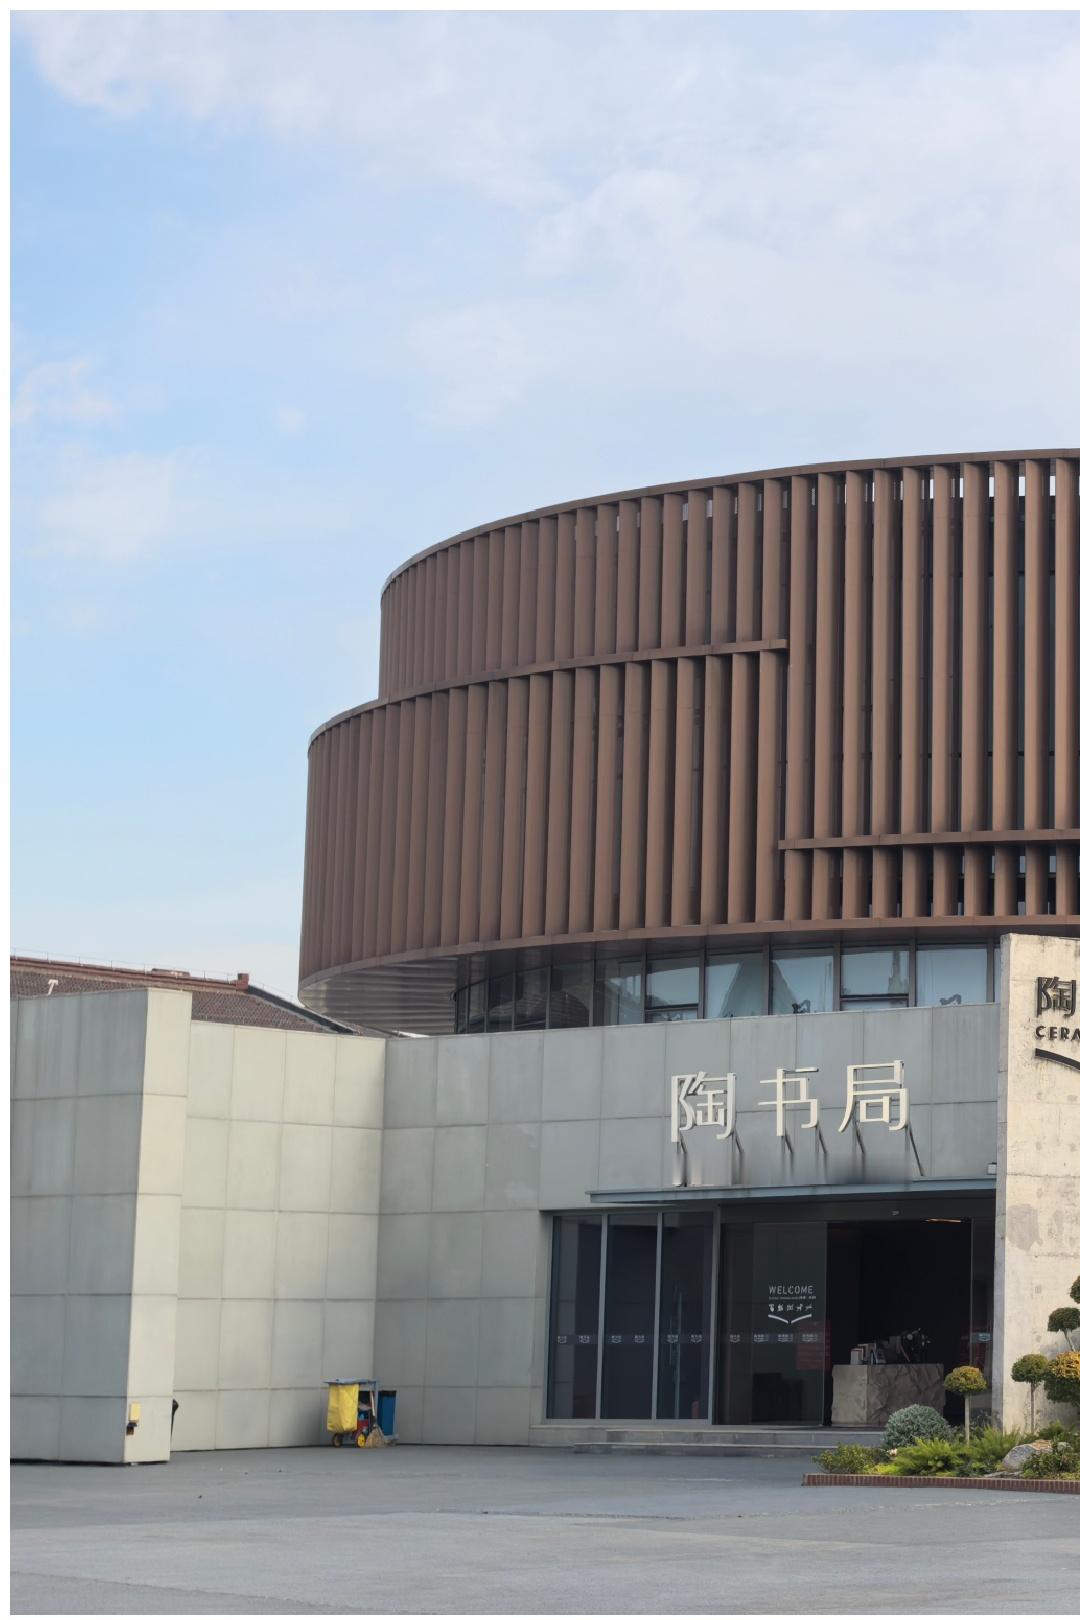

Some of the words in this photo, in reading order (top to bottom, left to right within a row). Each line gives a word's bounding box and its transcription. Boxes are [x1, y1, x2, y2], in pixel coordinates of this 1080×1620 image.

[671, 1060, 910, 1143] 陶书局
[768, 1285, 814, 1295] WELCOME
